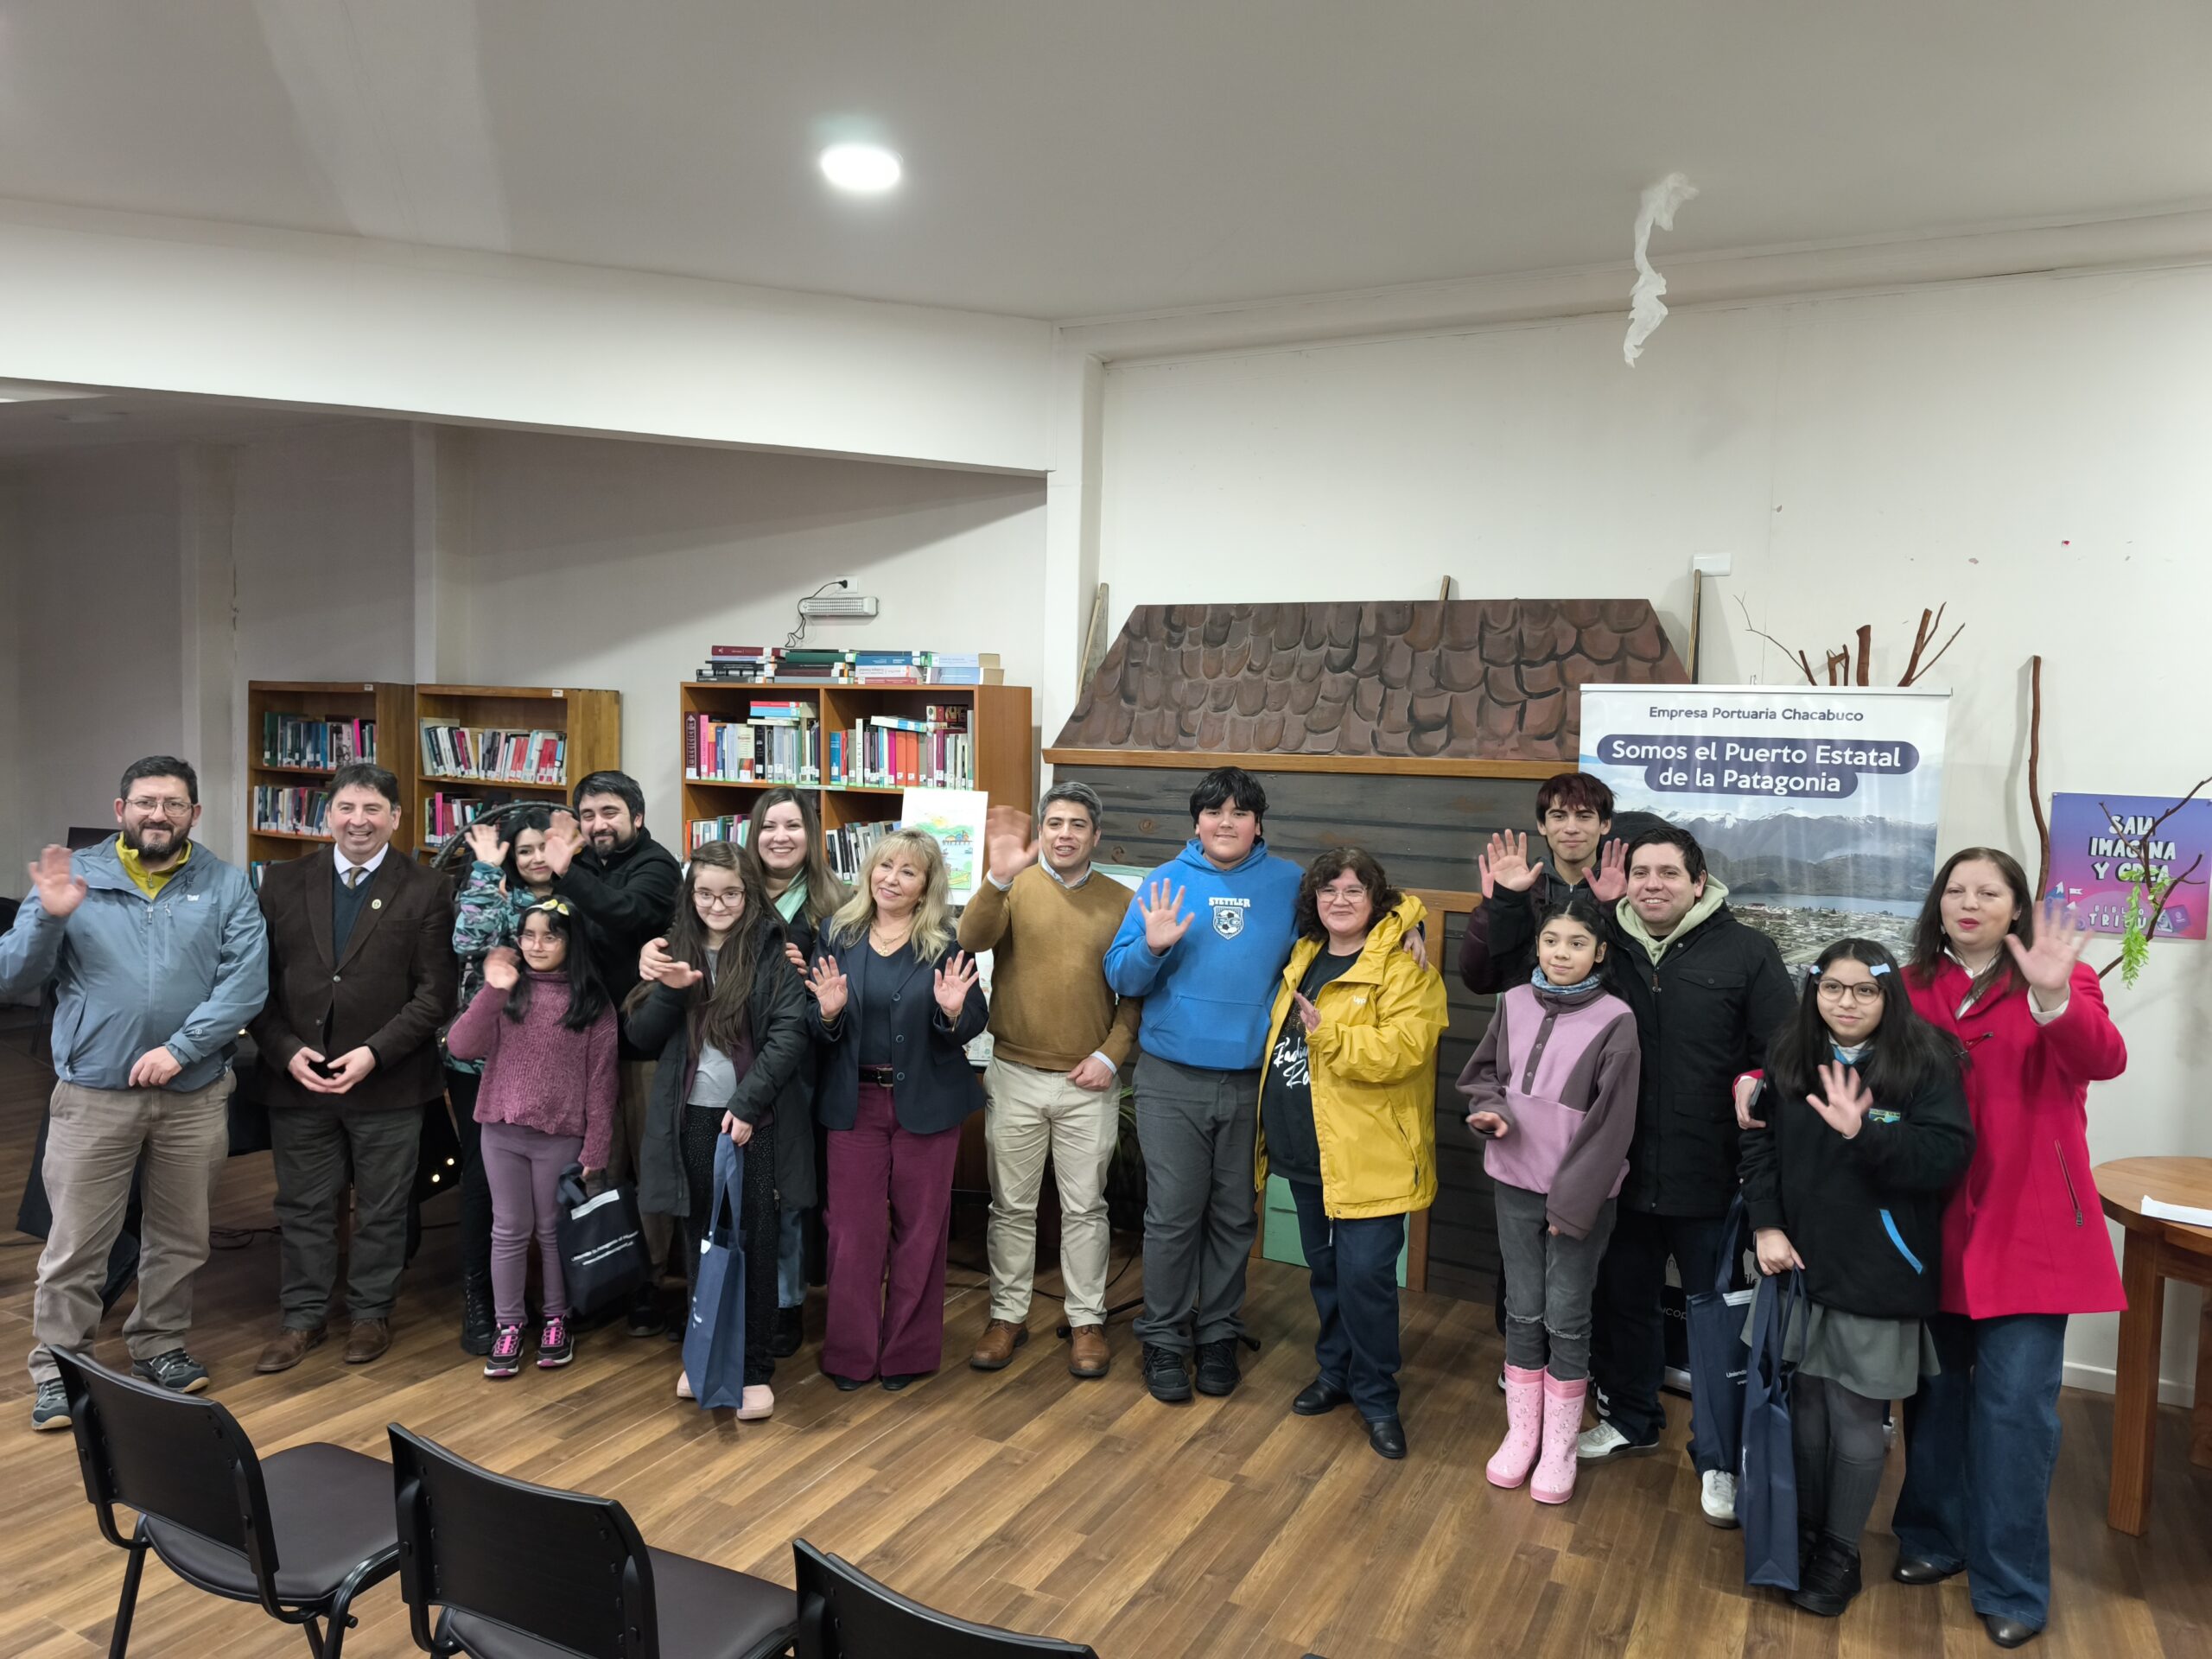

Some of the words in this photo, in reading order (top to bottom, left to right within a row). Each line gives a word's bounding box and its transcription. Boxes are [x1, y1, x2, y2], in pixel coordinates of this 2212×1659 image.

[1649, 706, 1708, 720] Empresa
[1712, 707, 1777, 720] Portuaria
[1782, 708, 1864, 721] Chacabuco
[1611, 740, 1688, 760] Somos
[1694, 741, 1717, 760] el
[1725, 742, 1808, 764] Puerto
[1815, 745, 1901, 767] Estatal
[1658, 766, 1688, 786] de
[1695, 767, 1715, 787] la
[1723, 769, 1841, 795] Patagonia
[2108, 814, 2155, 836] SALA
[2089, 836, 2177, 860] IMAGNA
[2092, 861, 2110, 880] Y
[2094, 904, 2145, 916] BIBLO
